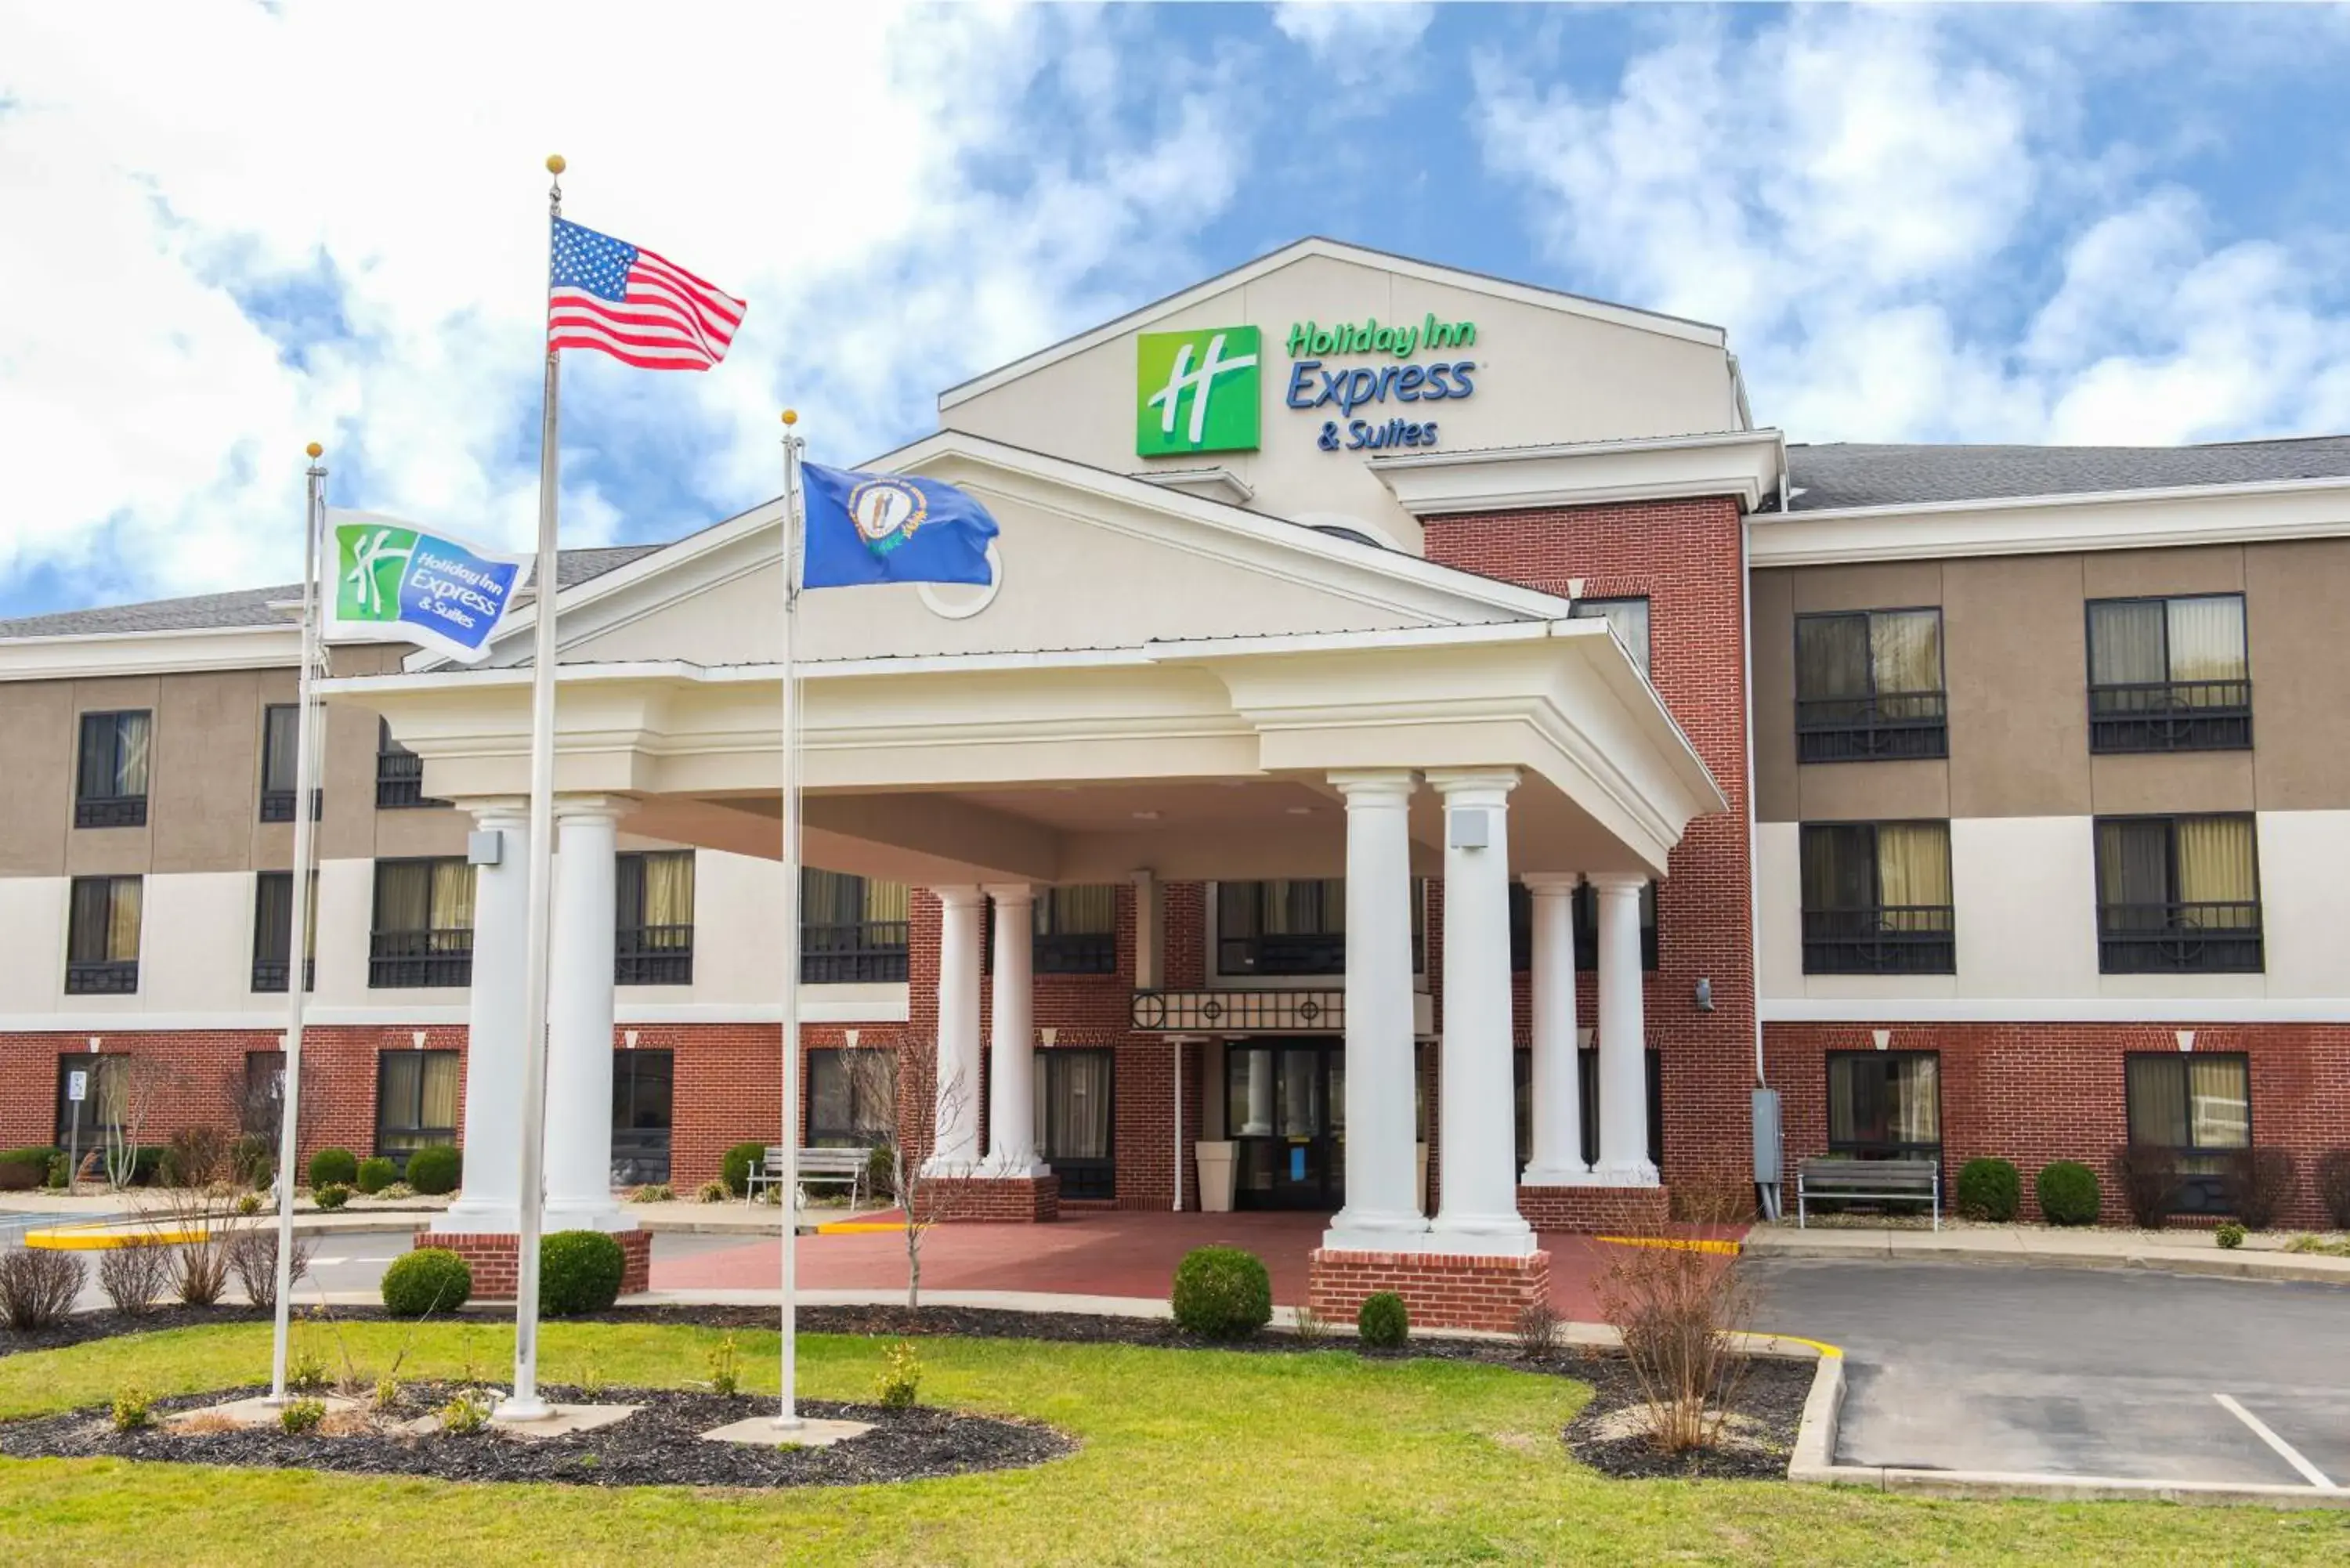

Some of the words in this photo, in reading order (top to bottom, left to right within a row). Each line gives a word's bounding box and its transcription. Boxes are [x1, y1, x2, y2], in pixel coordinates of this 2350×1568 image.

[1286, 318, 1416, 358] Holiday
[1423, 313, 1477, 350] Inn
[1285, 360, 1476, 417] Express
[1317, 421, 1340, 451] &
[1347, 418, 1438, 450] Suites
[410, 568, 497, 616] Express
[417, 552, 480, 585] Holiday
[479, 573, 503, 595] Inn
[418, 596, 432, 610] &
[432, 602, 476, 628] Suites
